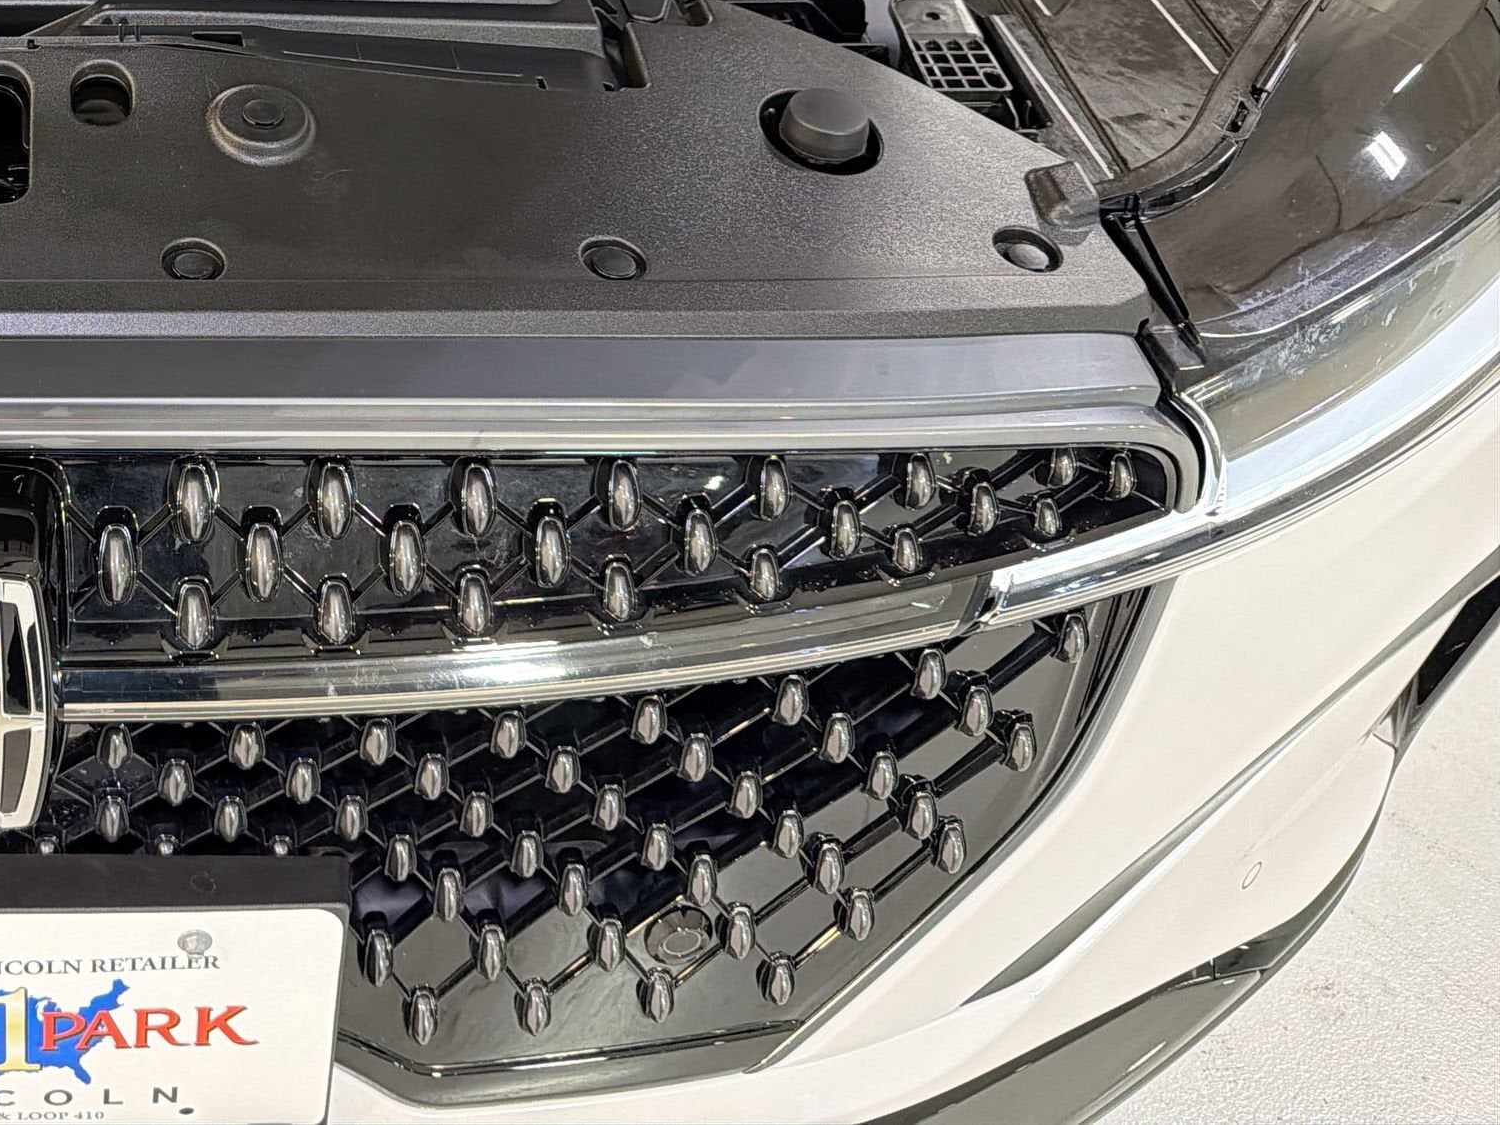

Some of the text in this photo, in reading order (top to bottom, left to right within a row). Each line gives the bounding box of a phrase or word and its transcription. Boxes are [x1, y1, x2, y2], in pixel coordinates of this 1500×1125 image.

[91, 956, 220, 973] RETAILER
[40, 1006, 260, 1051] PARK
[17, 1111, 69, 1121] LOOP
[73, 1111, 105, 1121] 410
